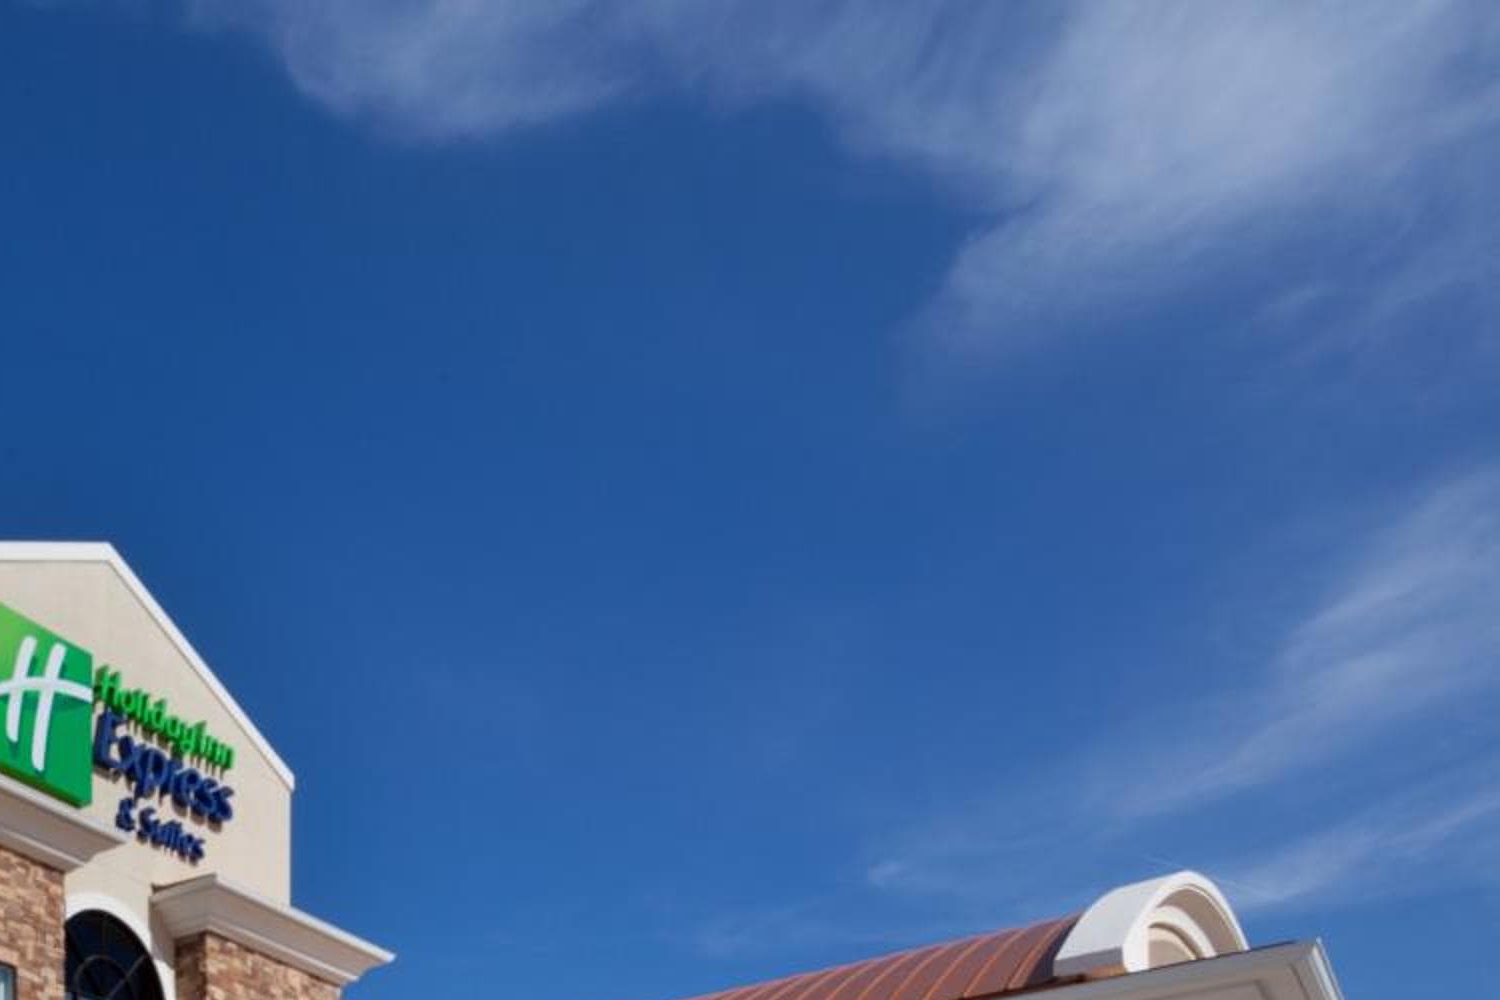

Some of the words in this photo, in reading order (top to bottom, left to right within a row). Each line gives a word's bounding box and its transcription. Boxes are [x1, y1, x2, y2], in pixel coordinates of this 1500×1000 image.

[95, 664, 194, 756] Holiday
[94, 706, 234, 821] Express
[115, 798, 135, 832] &
[137, 807, 205, 864] Suites
